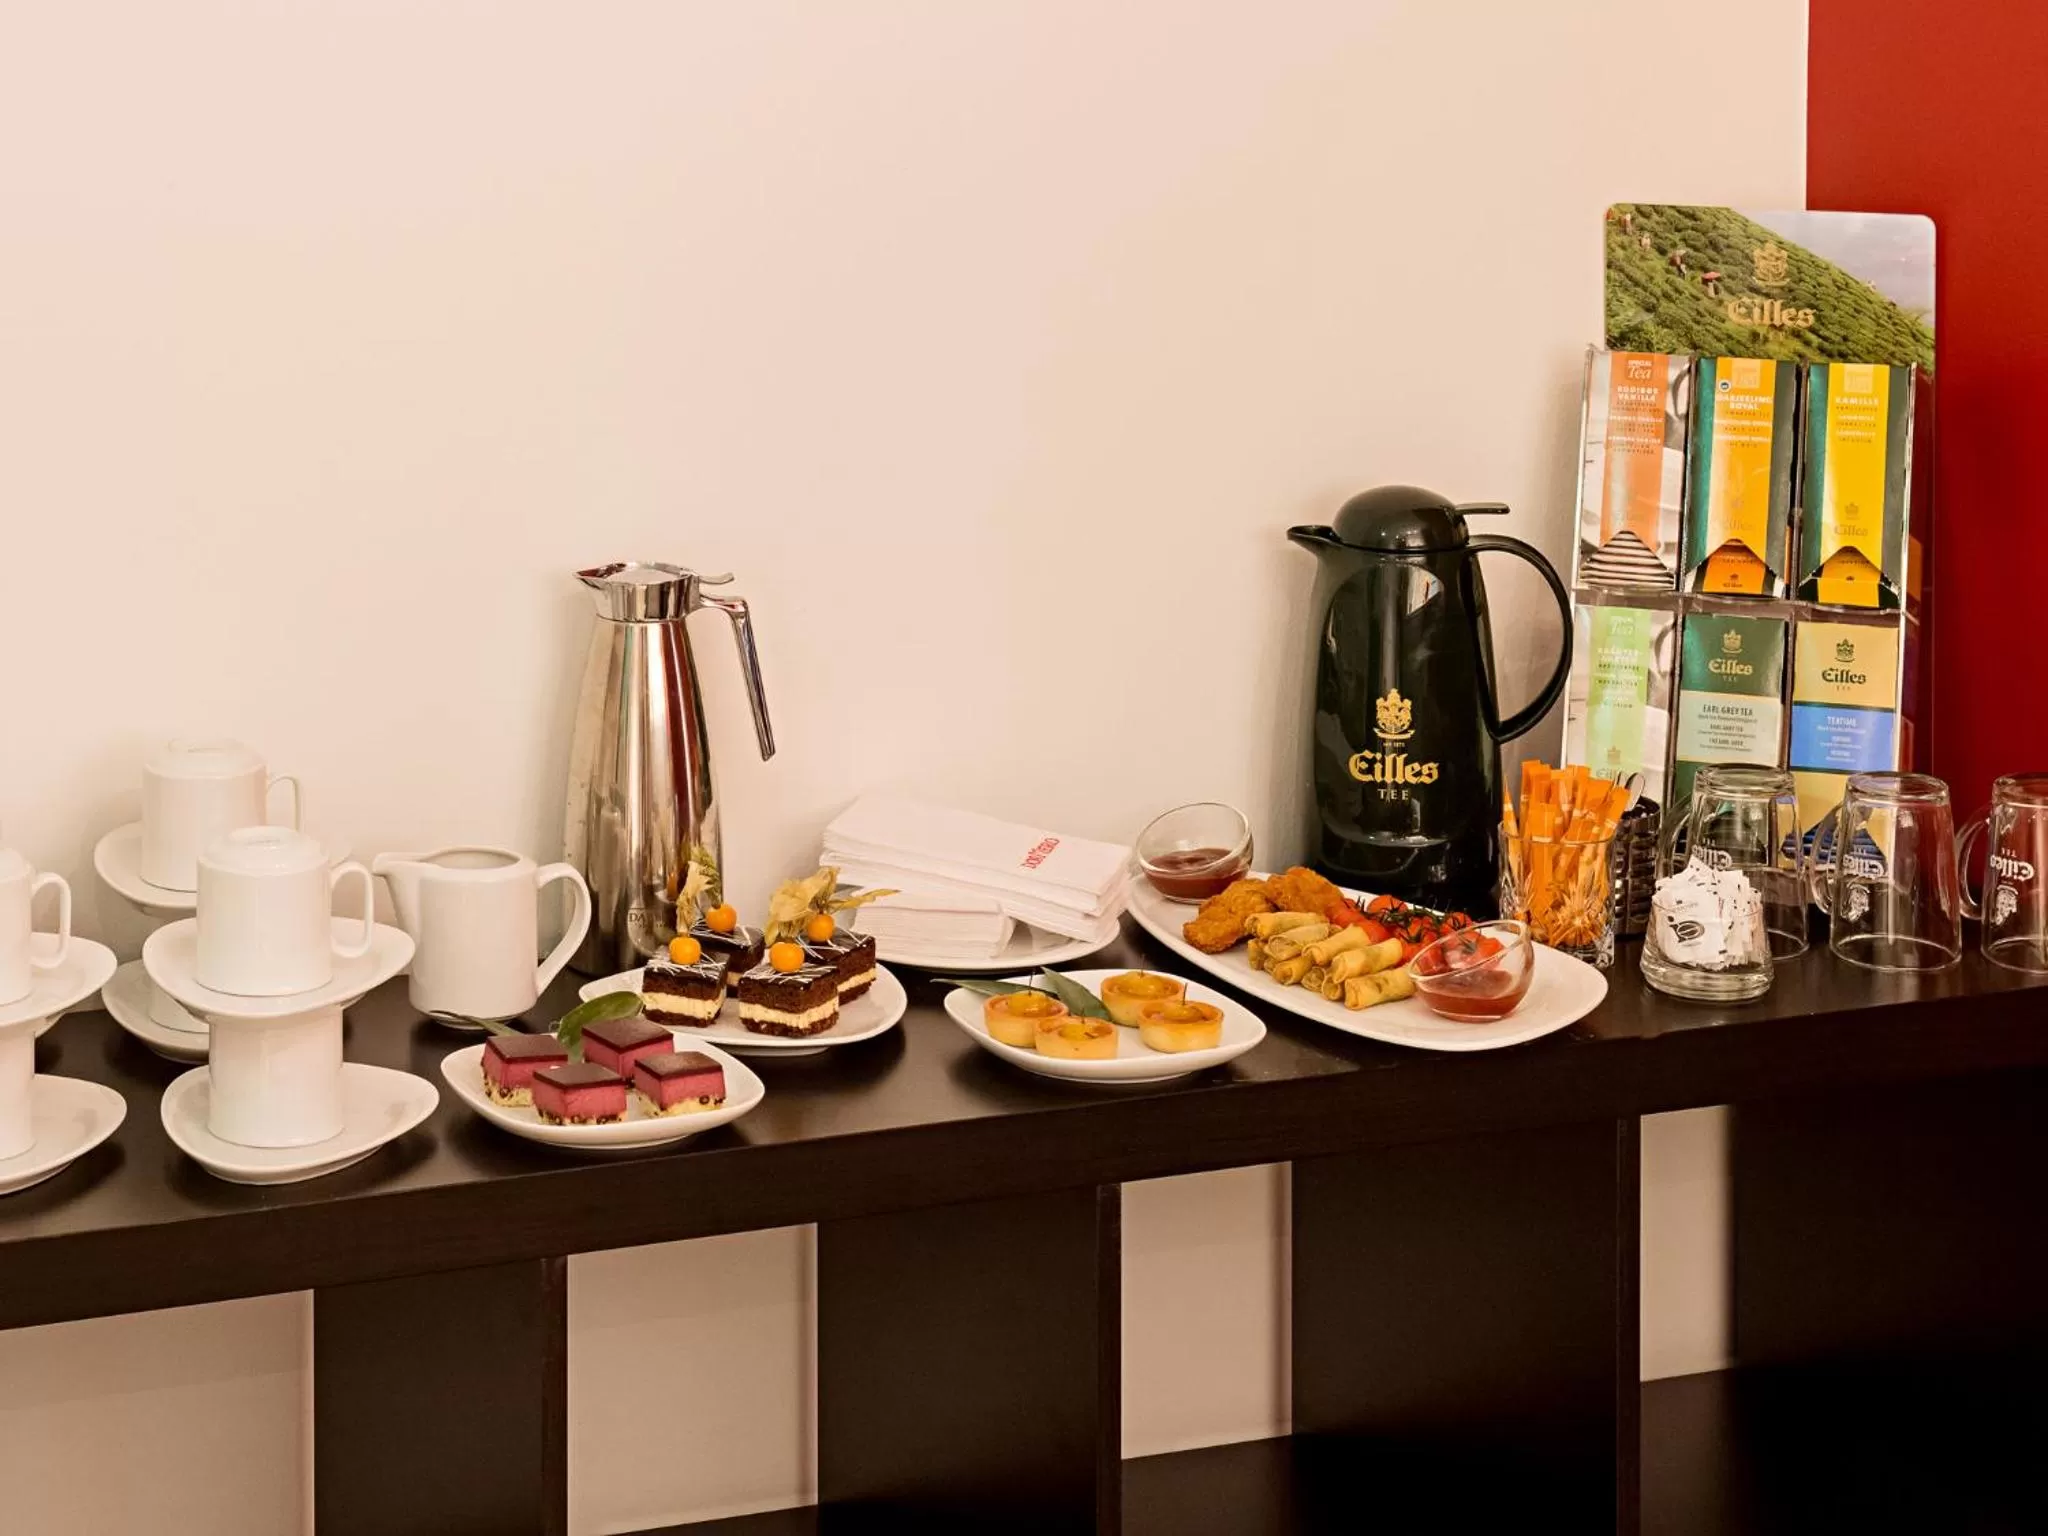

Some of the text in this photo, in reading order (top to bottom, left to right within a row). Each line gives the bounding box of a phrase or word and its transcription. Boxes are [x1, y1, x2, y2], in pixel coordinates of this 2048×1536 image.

[1727, 297, 1817, 328] Eilles
[1628, 366, 1653, 380] Tea
[1708, 658, 1754, 676] Eilles
[1821, 667, 1867, 685] Eilles
[1703, 703, 1753, 717] EARL GREY TEA
[1348, 749, 1440, 785] Eilles
[1377, 788, 1409, 800] TEE
[1990, 854, 2035, 882] Eilles
